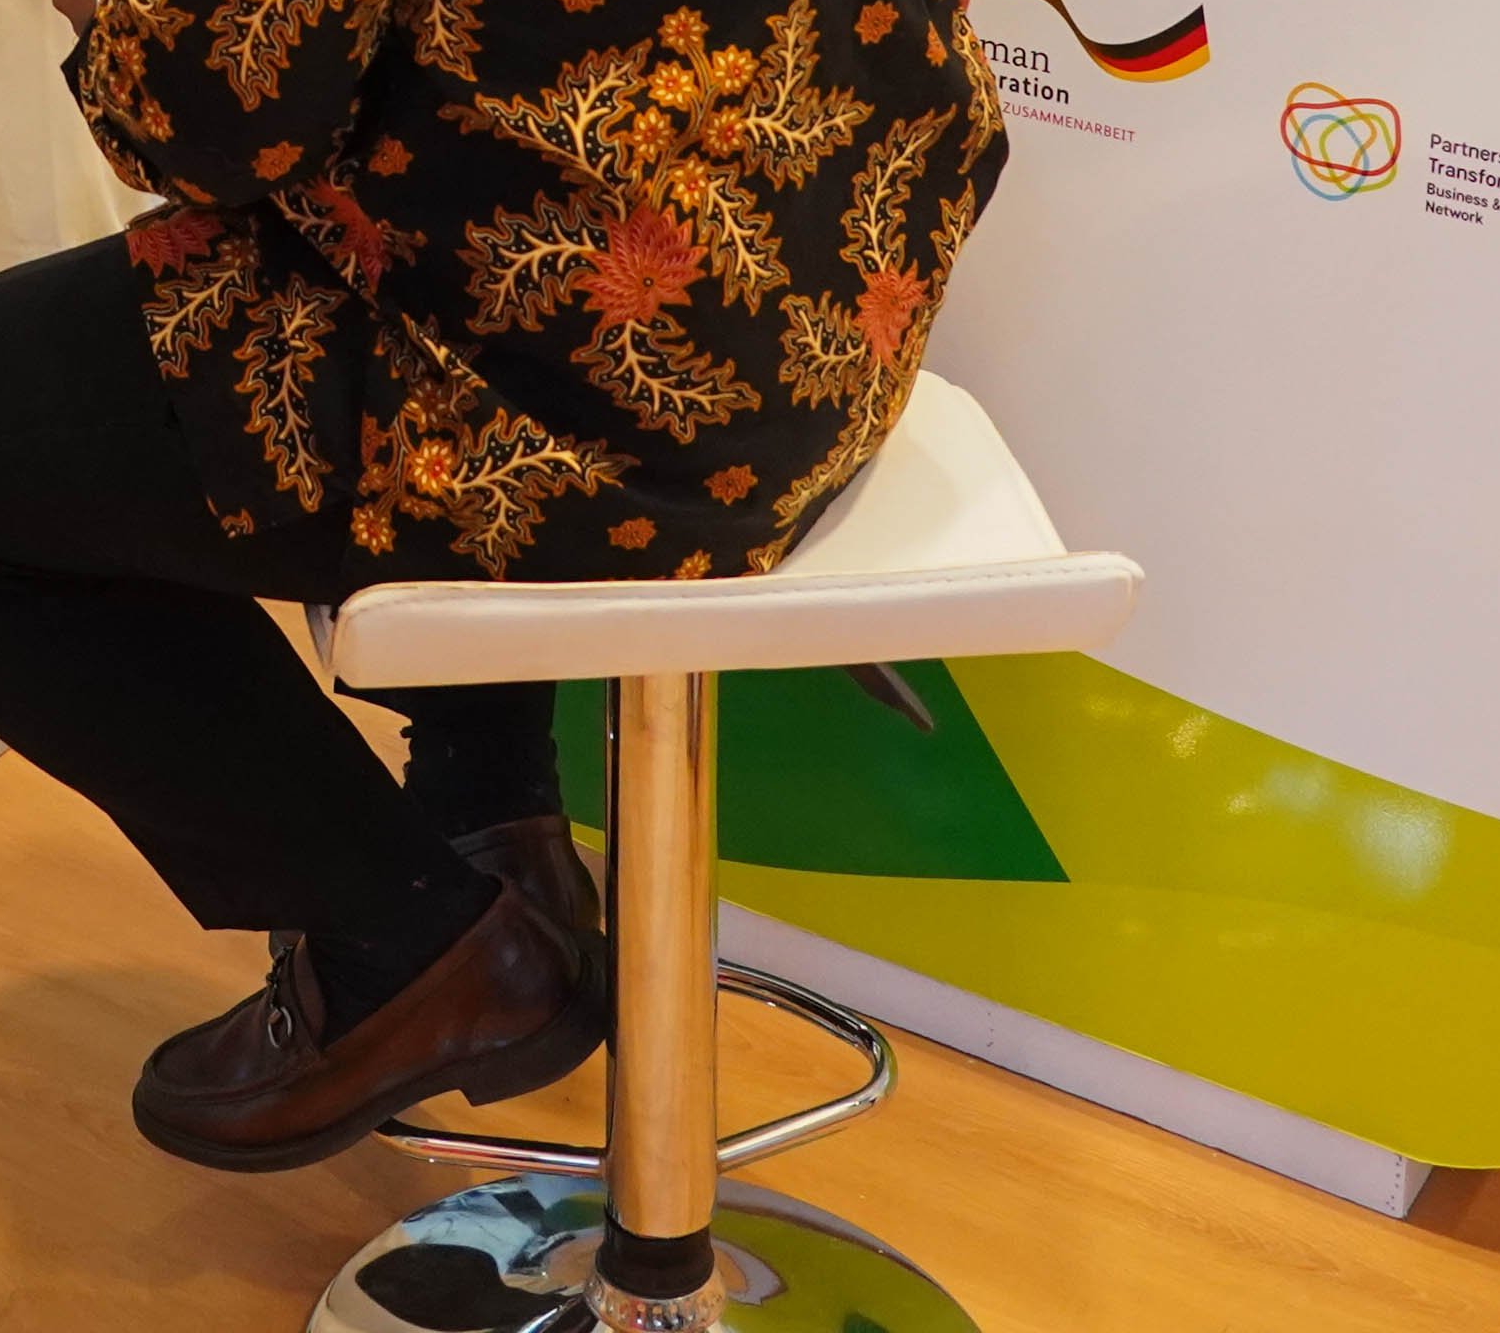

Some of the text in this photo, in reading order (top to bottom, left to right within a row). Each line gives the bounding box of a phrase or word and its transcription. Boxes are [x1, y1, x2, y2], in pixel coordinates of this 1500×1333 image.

[1003, 102, 1134, 141] ZUSAMMENARBEIT
[1426, 182, 1488, 207] Business
[1492, 198, 1500, 210] &
[1426, 200, 1482, 224] Network
